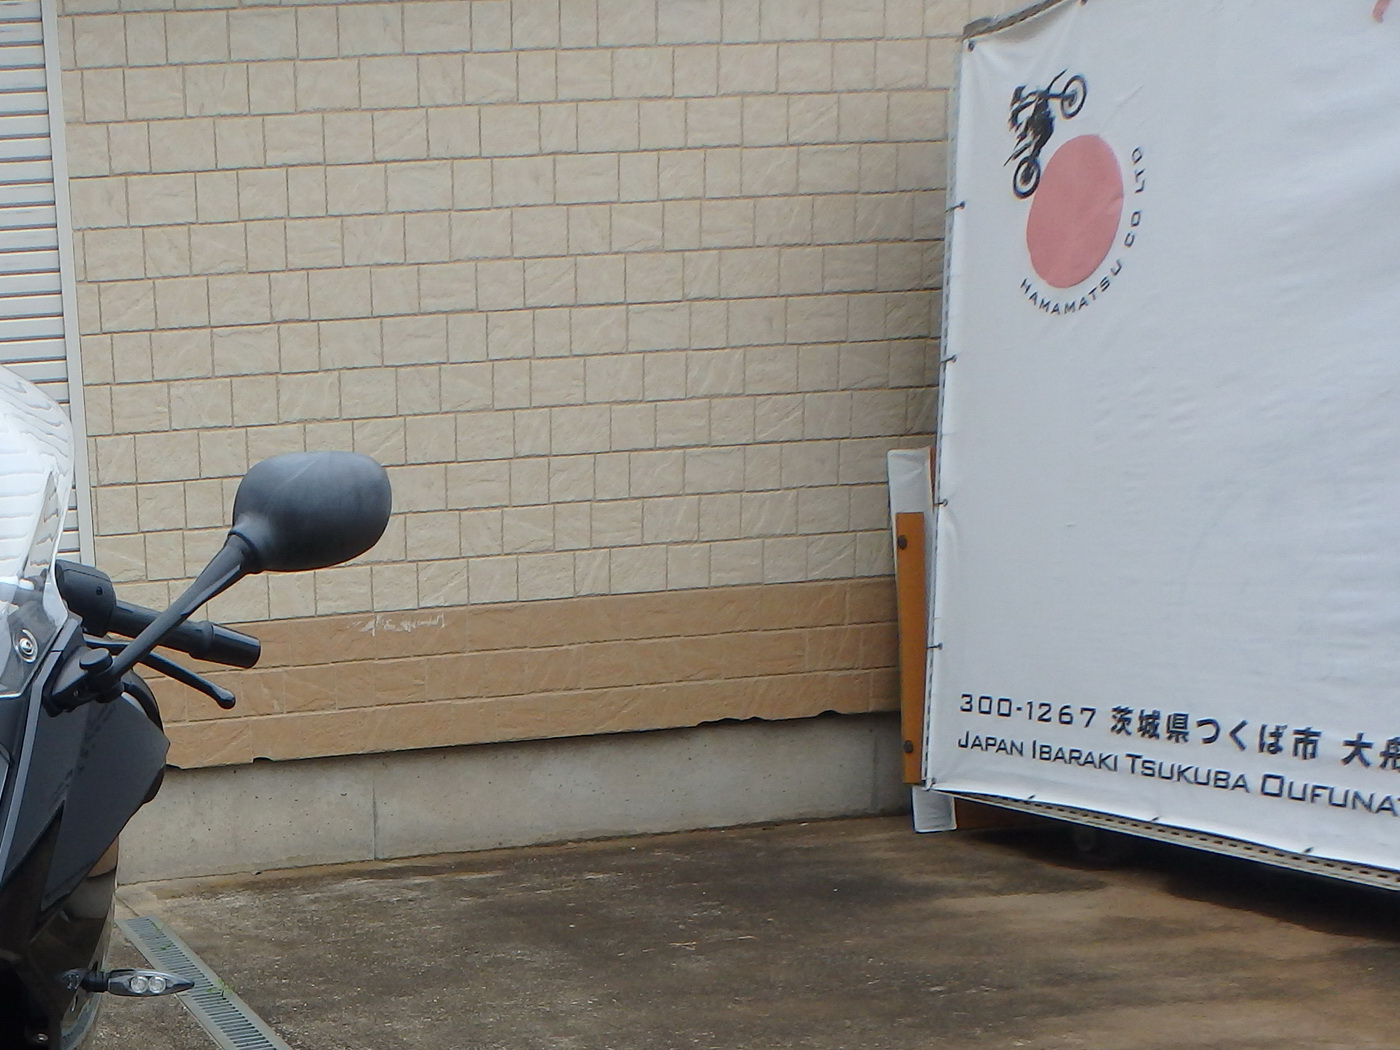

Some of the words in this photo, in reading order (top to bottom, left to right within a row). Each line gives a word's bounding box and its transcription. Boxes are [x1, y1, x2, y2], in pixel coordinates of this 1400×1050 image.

[1020, 259, 1122, 316] HAMAMATSU
[960, 693, 1097, 729] 300-1267
[1110, 706, 1322, 761] 茨城県つくば市
[958, 731, 1024, 758] JAPAN
[1032, 740, 1118, 773] IBARAKI
[1125, 753, 1250, 793] TSUKUBA
[1261, 773, 1400, 818] OUFUNA
